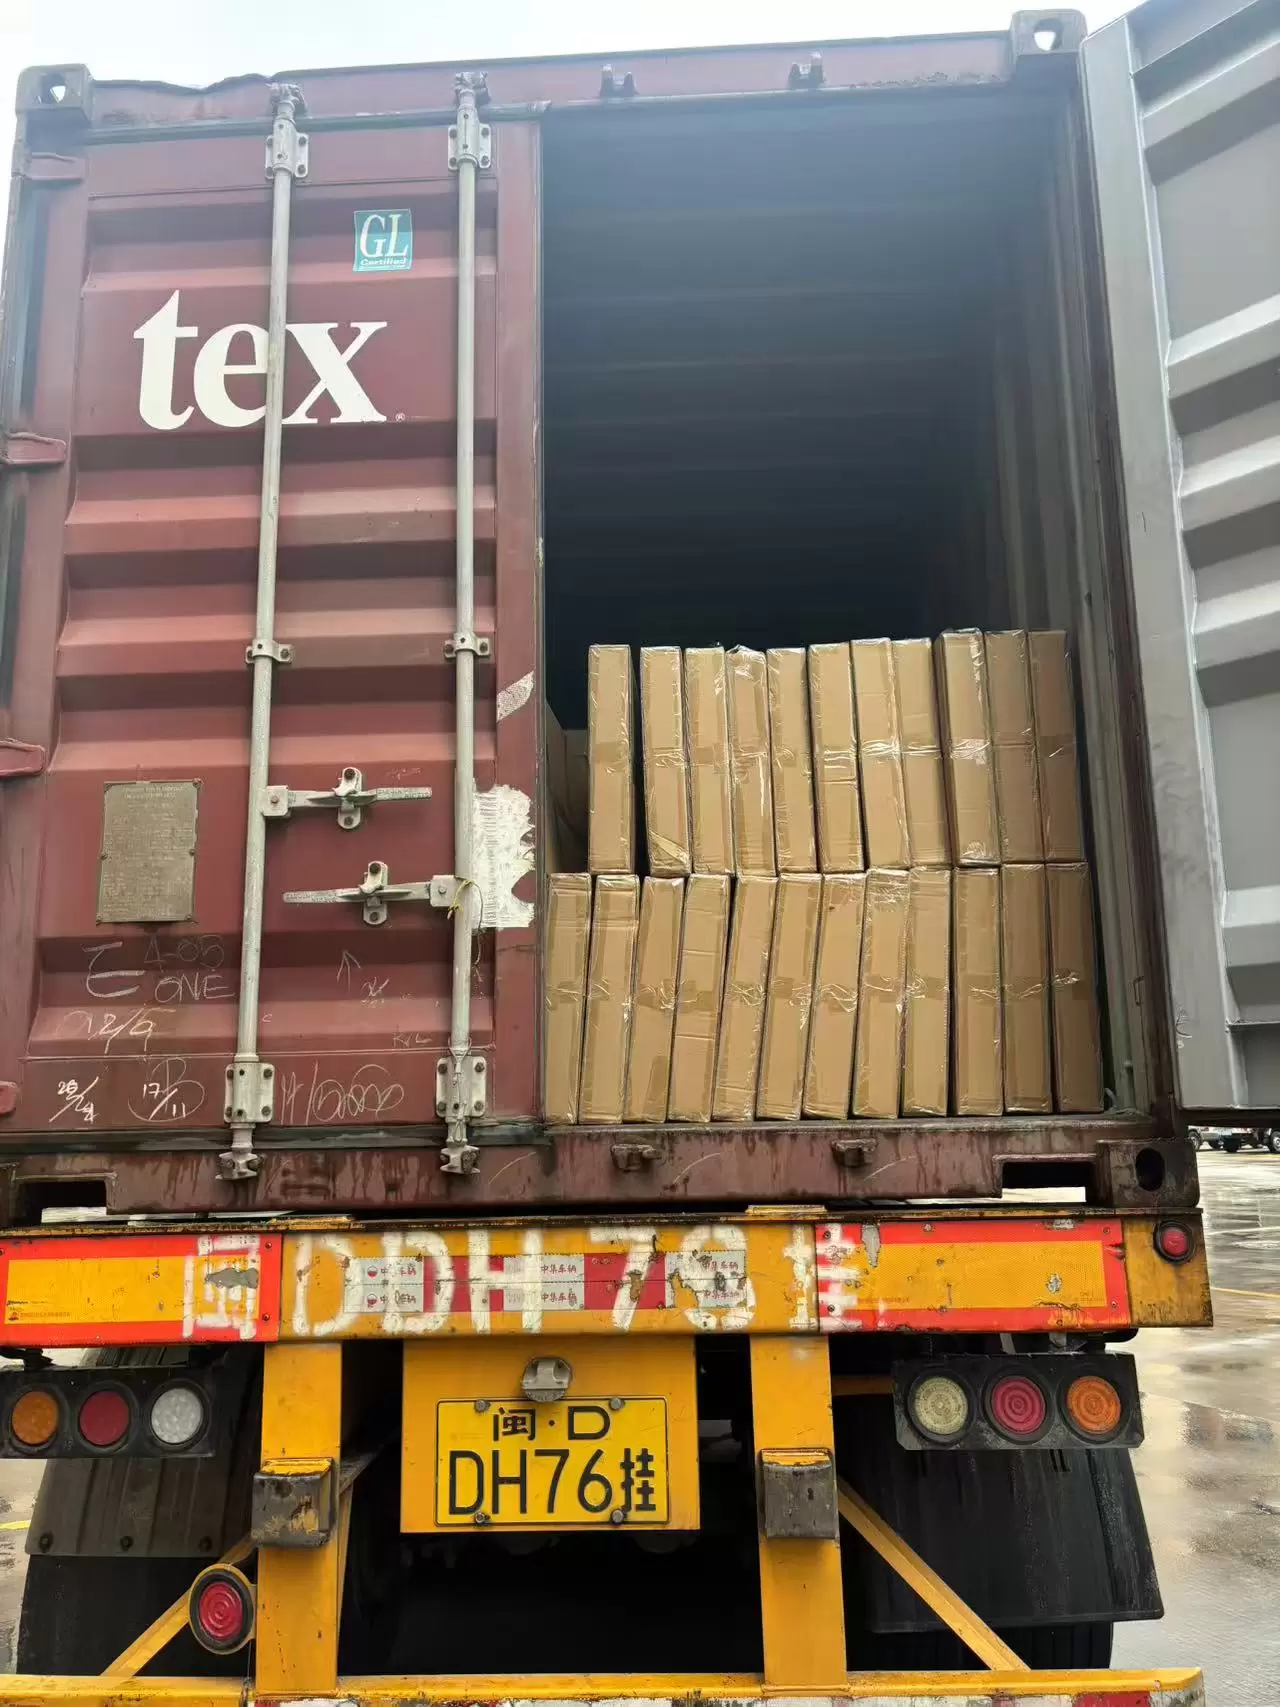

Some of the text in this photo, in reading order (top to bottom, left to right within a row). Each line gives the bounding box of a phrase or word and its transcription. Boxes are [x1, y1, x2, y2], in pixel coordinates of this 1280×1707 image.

[360, 213, 409, 258] GL
[360, 257, 407, 266] Certified
[133, 289, 388, 430] tex
[155, 972, 236, 1003] ONE
[540, 1263, 577, 1275] 中集车辆
[448, 1447, 657, 1516] DH76挂
